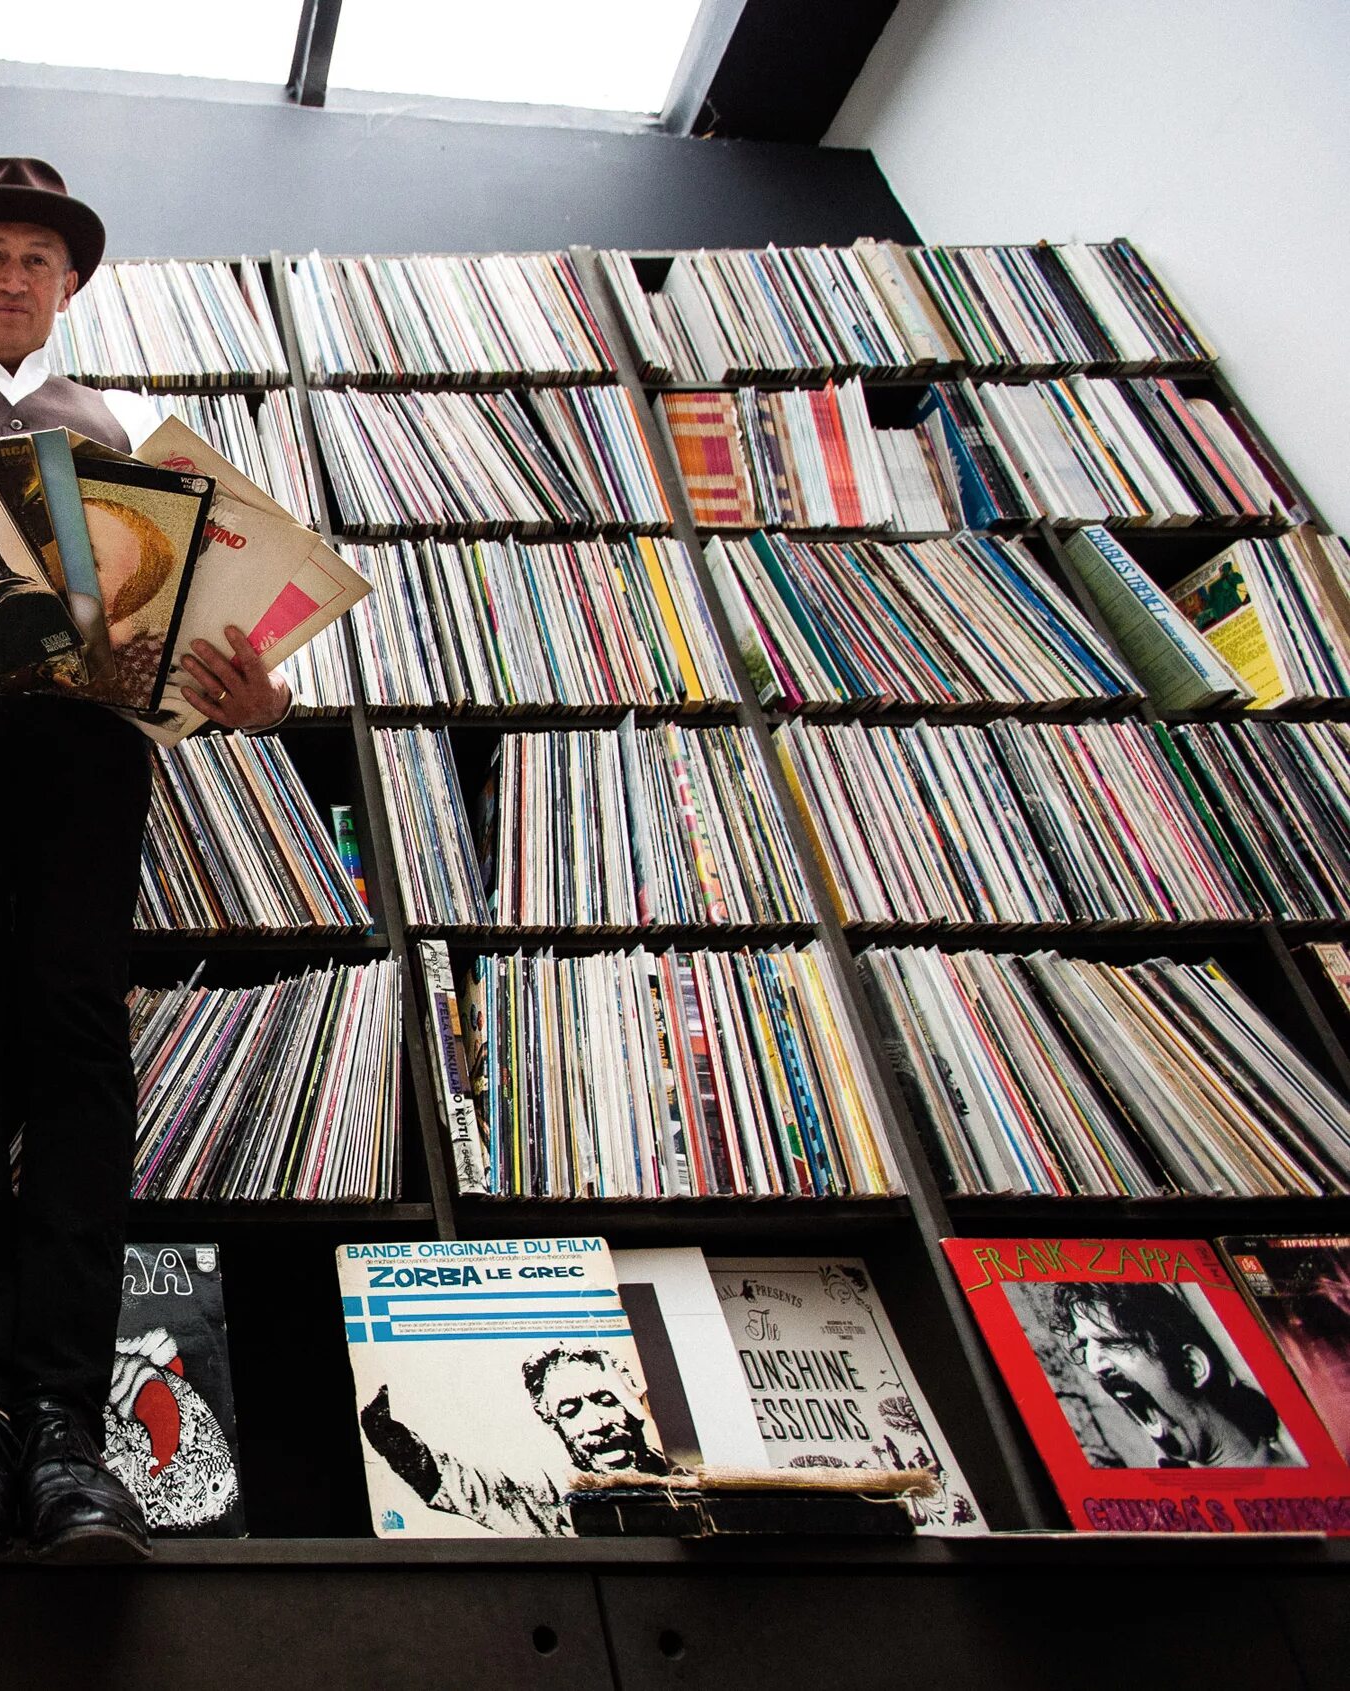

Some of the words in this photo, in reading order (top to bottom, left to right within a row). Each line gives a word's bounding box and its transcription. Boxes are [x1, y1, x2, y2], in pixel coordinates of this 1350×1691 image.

[1087, 529, 1138, 578] CHARLES
[1125, 574, 1169, 618] TRENET
[429, 951, 438, 967] BOX
[432, 968, 440, 983] SET
[437, 1001, 450, 1030] FELA
[441, 1033, 463, 1103] ANIKULAPO
[454, 1107, 468, 1138] KUTI
[346, 1245, 412, 1259] BANDE
[417, 1241, 519, 1257] ORIGINALE
[524, 1240, 551, 1254] DU
[556, 1239, 602, 1253] FILM
[367, 1265, 483, 1288] ZORBA
[485, 1268, 513, 1280] LE
[518, 1266, 585, 1279] GREC
[967, 1240, 1082, 1292] FRANK
[1080, 1242, 1239, 1292] ZAPPA
[755, 1284, 804, 1309] PRESENTS
[744, 1308, 781, 1342] The
[738, 1350, 868, 1393] ONSHINE
[752, 1398, 873, 1443] ESSIONS
